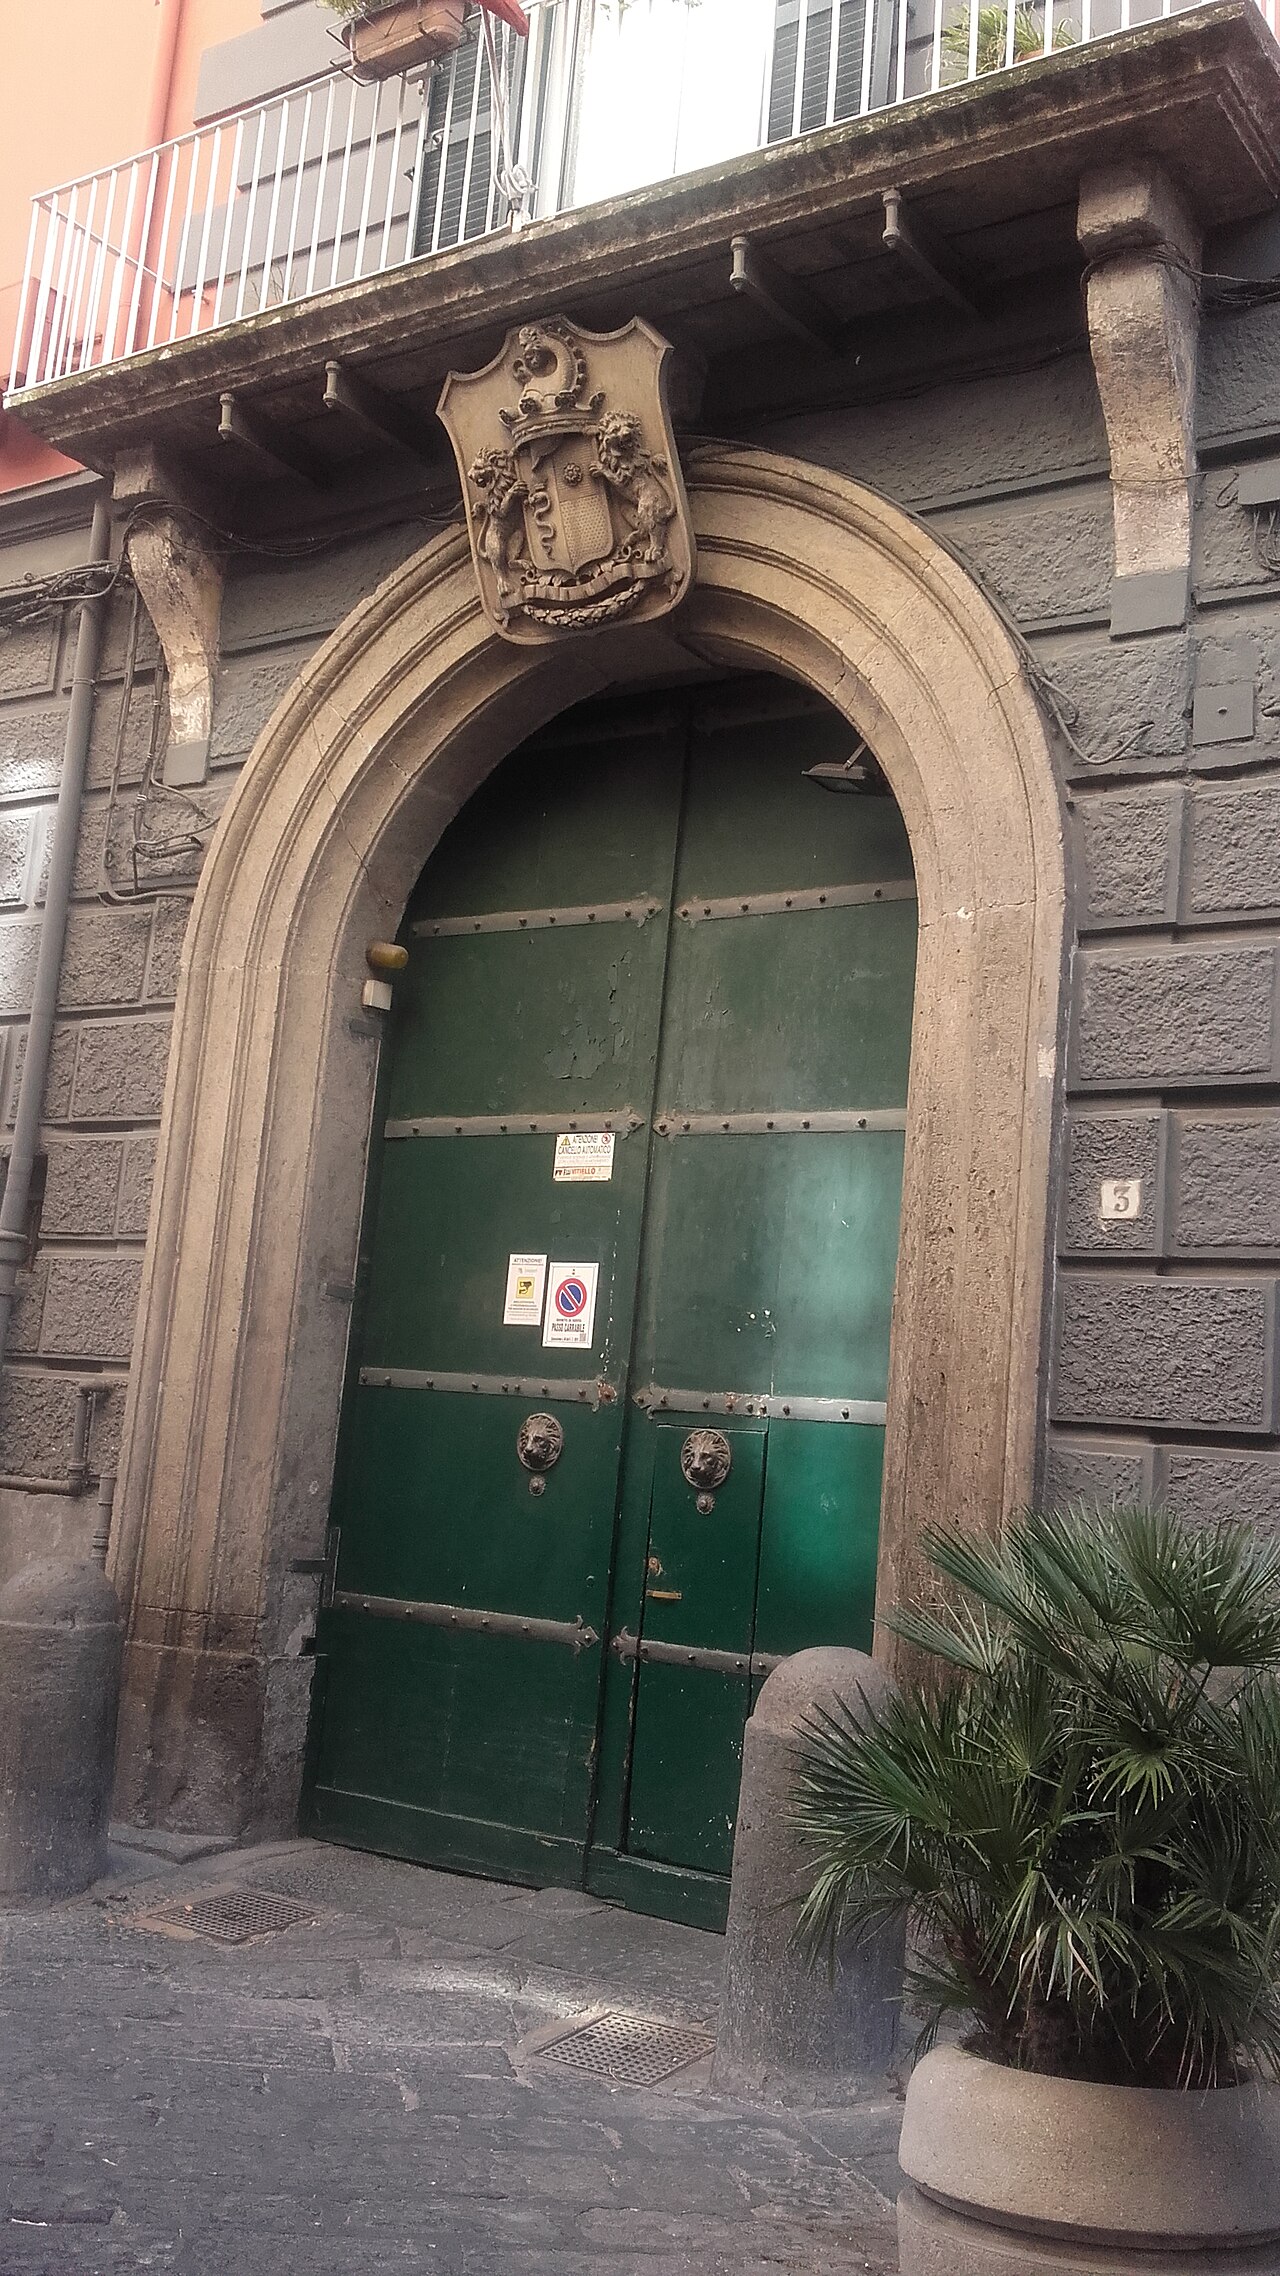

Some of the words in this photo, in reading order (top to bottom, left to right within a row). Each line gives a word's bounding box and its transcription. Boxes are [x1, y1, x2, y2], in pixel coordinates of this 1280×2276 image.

[558, 1146, 581, 1155] CANCELLO
[582, 1145, 611, 1154] AUTOMATICO
[1114, 1185, 1131, 1212] 3
[551, 1323, 563, 1332] PASSO
[564, 1323, 585, 1332] CARRABILE
